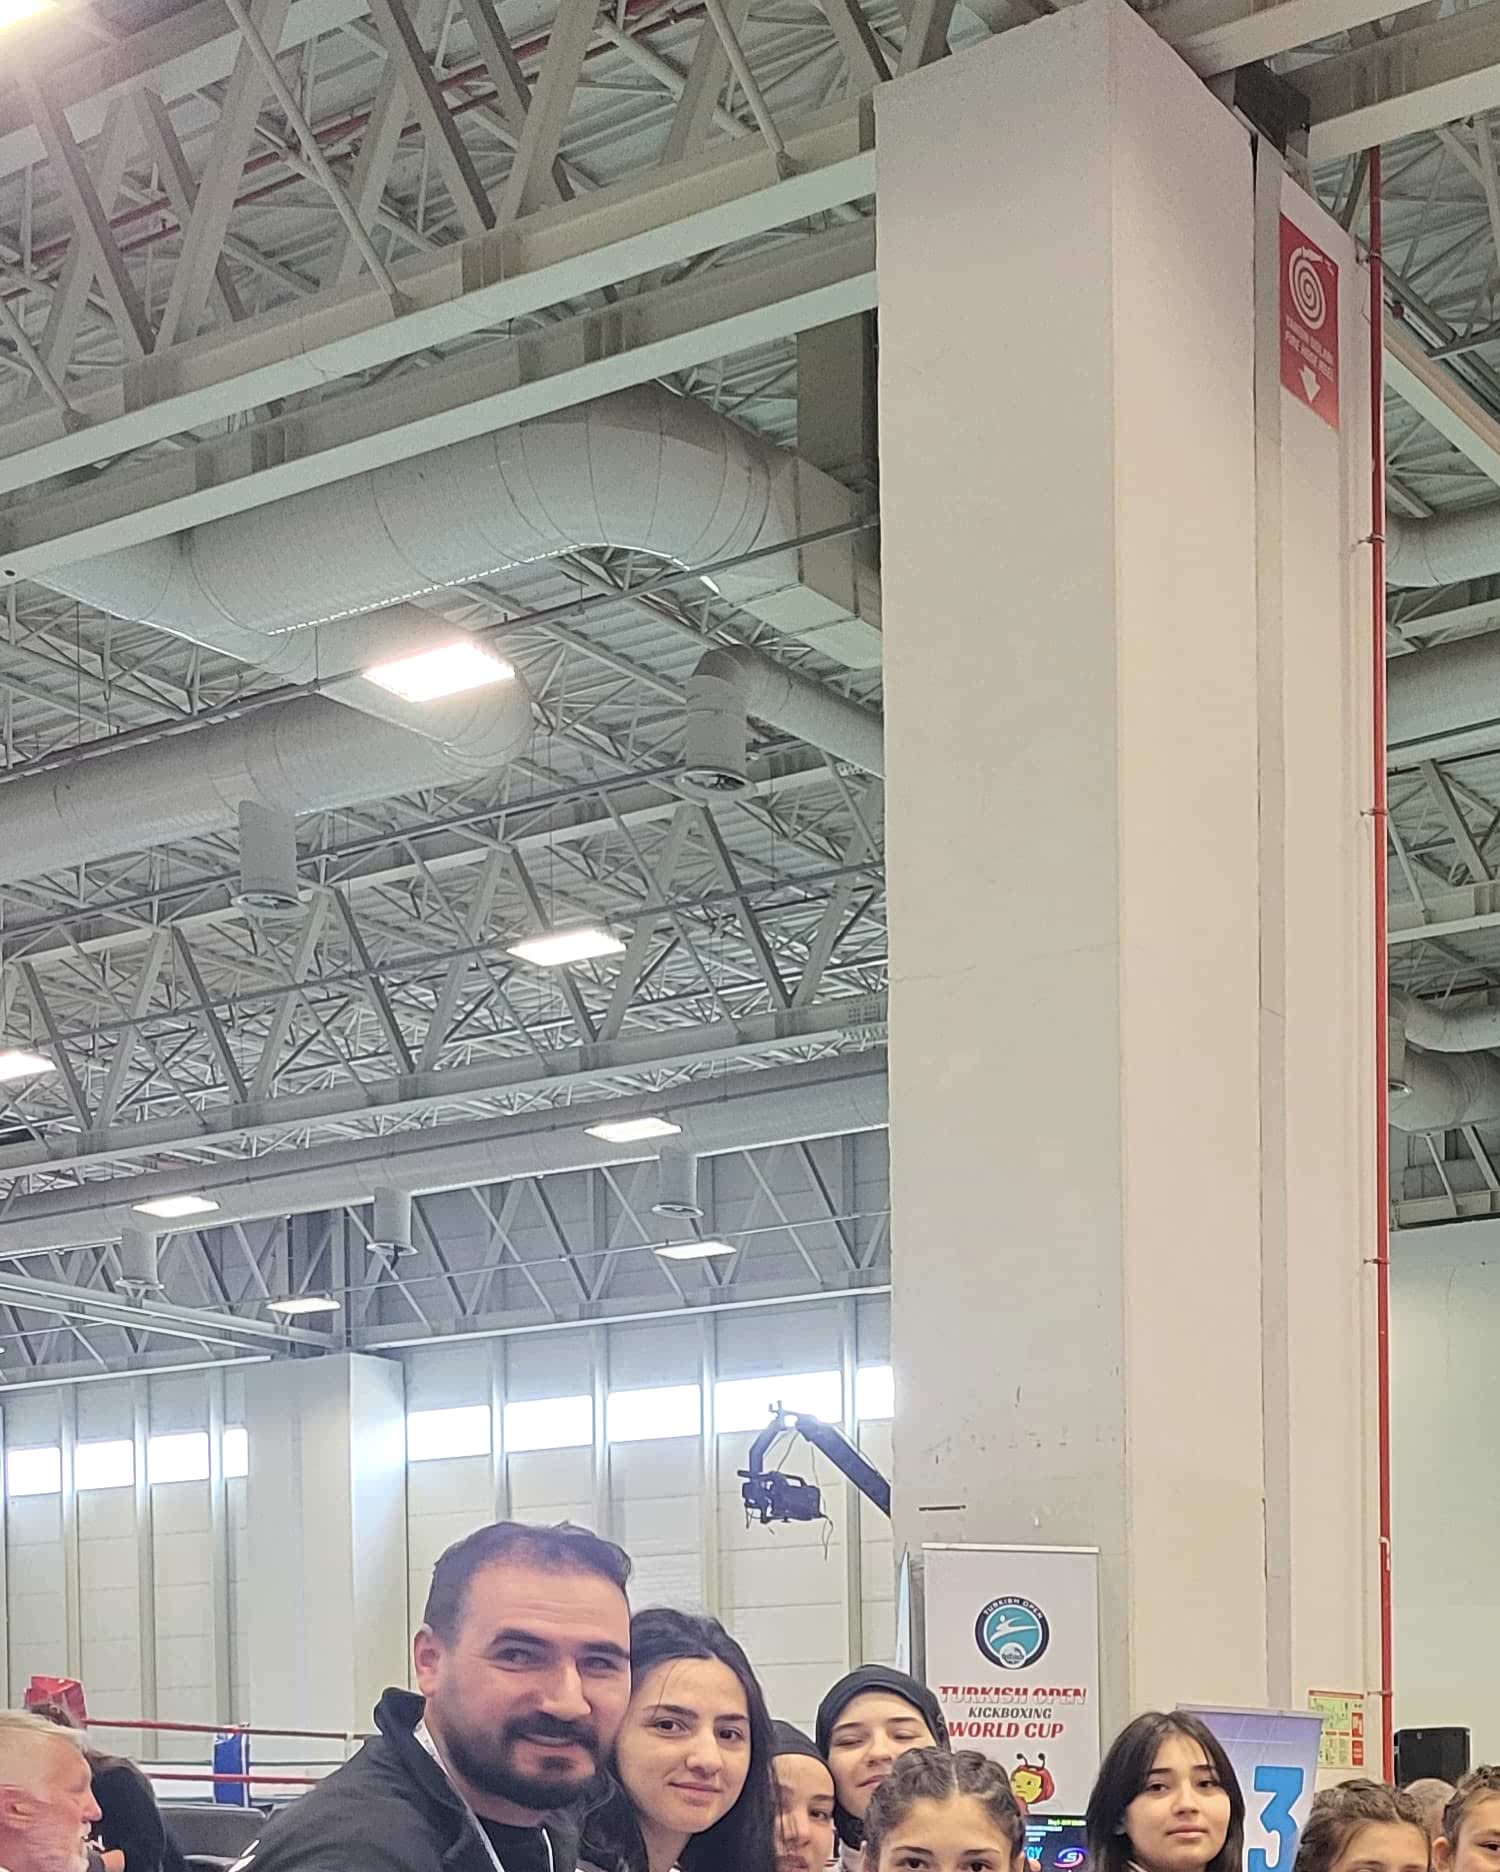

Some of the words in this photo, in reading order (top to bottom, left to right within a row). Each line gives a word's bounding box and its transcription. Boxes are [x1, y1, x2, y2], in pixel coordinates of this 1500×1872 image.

[939, 1686, 1029, 1705] TURKISH
[1031, 1687, 1088, 1707] OPEN
[968, 1706, 1053, 1719] KICKBOXING
[948, 1721, 1020, 1738] WORLD
[1024, 1723, 1064, 1739] CUP
